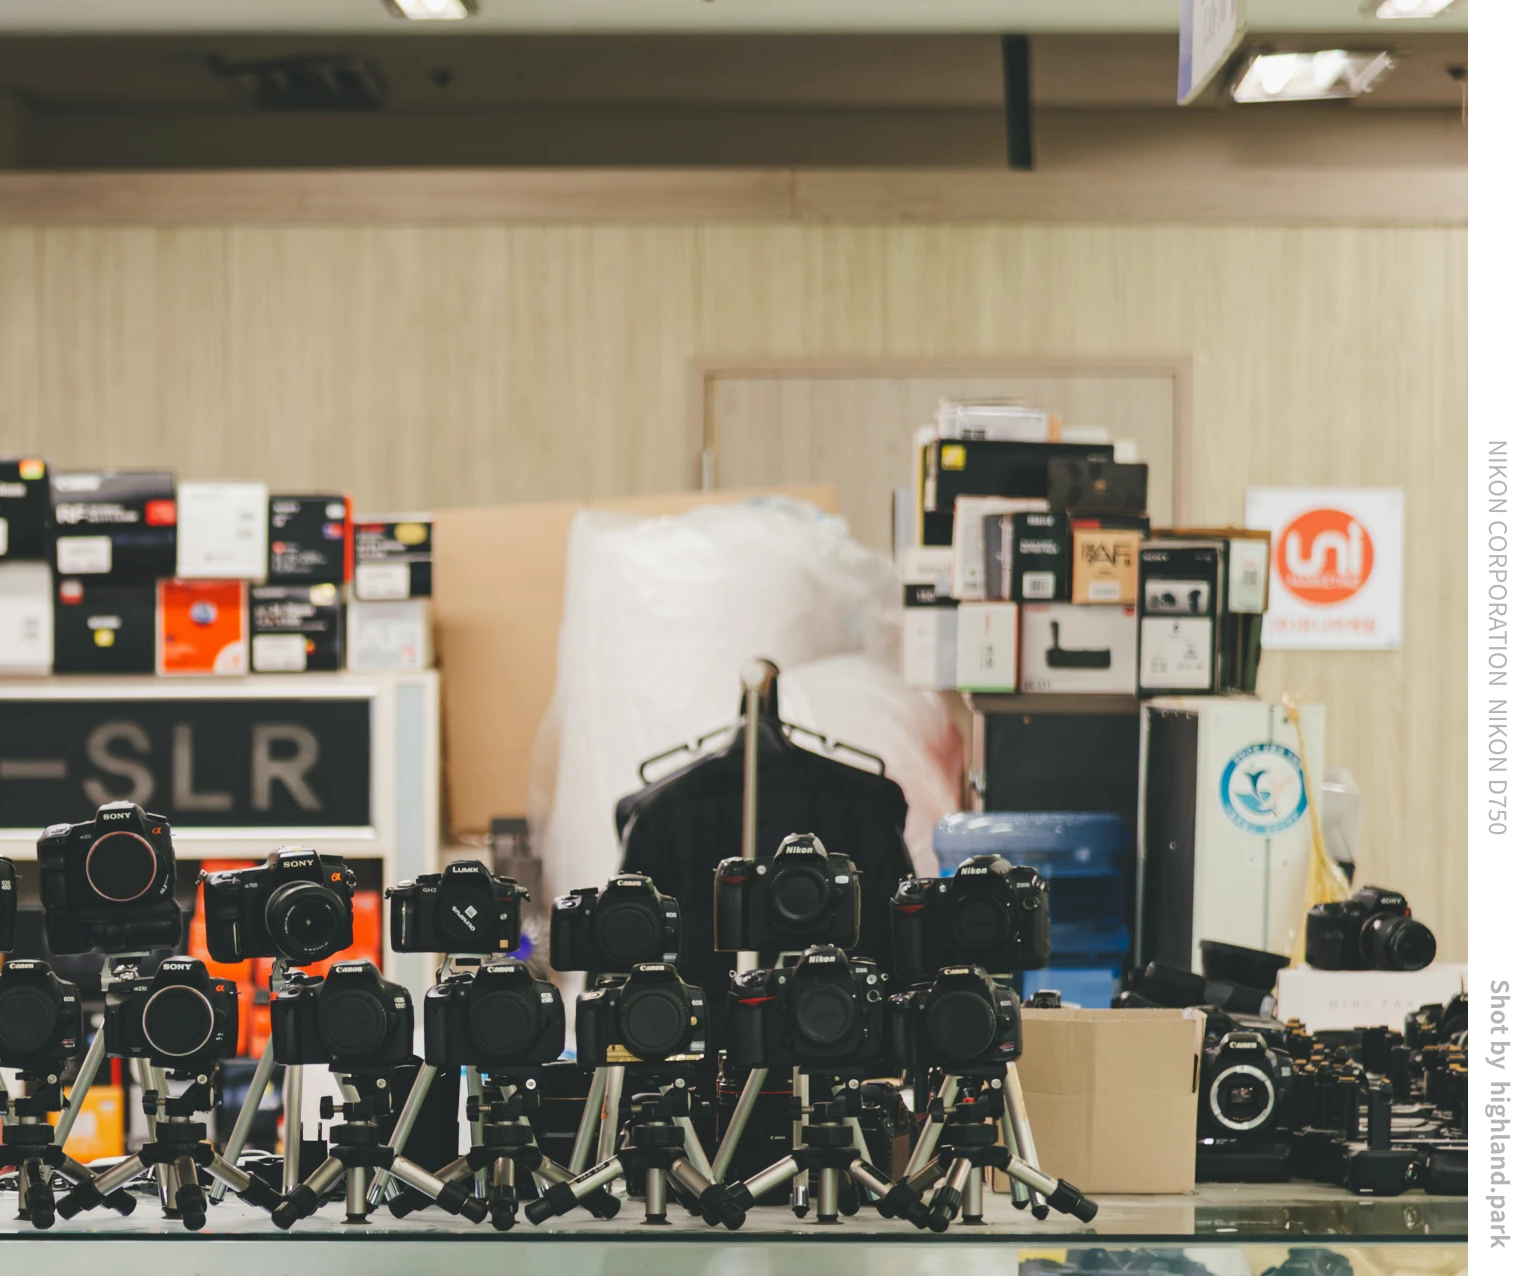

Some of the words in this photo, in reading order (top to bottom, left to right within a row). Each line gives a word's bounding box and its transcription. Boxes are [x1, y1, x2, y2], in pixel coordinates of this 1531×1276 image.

[451, 905, 476, 932] OLYMPUS
[9, 962, 34, 970] Canon
[487, 965, 515, 973] Canon
[944, 967, 969, 975] Canon
